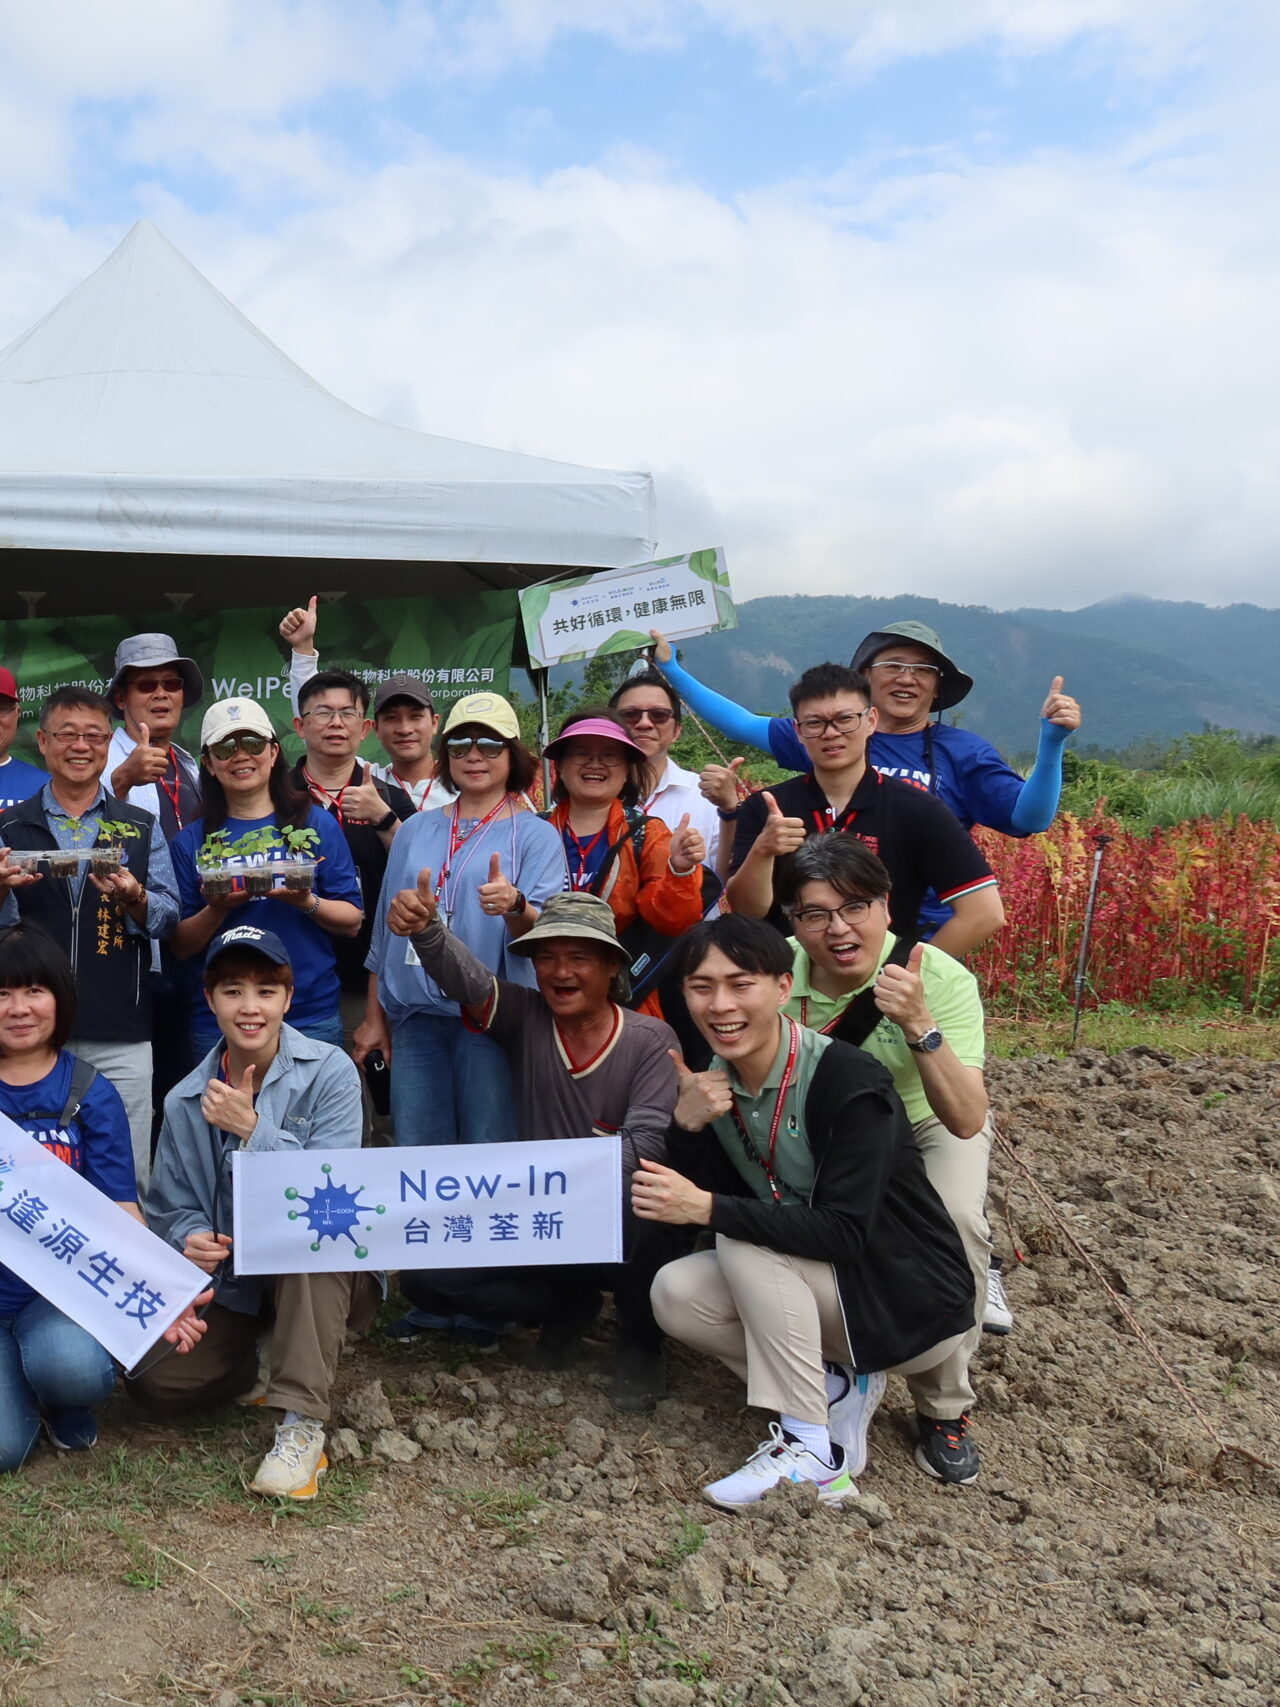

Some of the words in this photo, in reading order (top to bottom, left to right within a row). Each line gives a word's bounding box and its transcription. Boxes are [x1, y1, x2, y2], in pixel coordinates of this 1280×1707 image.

[211, 677, 292, 700] WelPe
[427, 687, 493, 699] orporation
[223, 931, 262, 945] Made
[399, 1165, 567, 1202] New-In
[0, 1189, 167, 1330] 逢源生技
